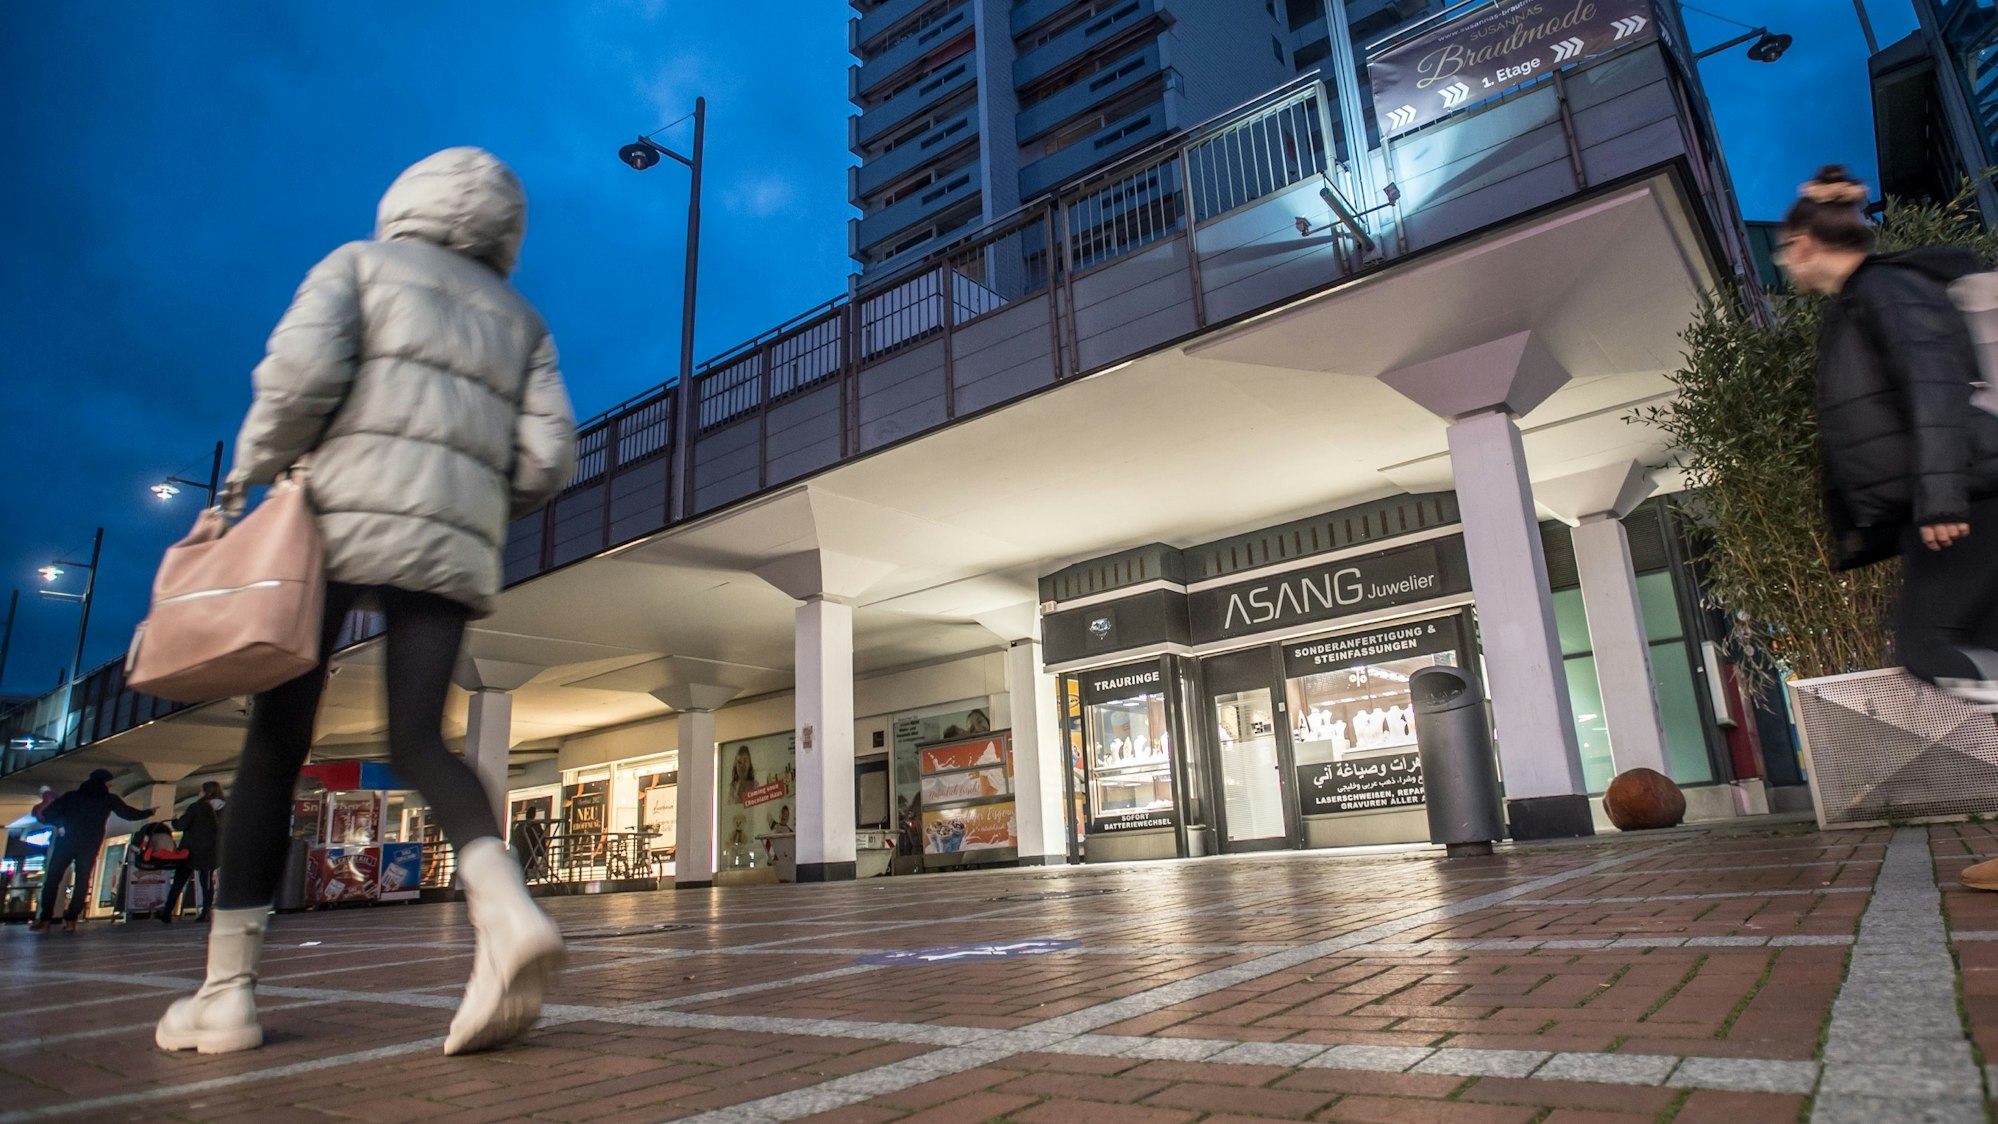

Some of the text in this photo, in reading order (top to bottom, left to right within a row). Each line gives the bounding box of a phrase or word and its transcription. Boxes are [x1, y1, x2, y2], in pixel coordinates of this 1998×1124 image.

[1437, 0, 1535, 42] www.susannas-brautm
[1470, 4, 1543, 41] SUSANNAS
[1416, 0, 1597, 89] Brautmode
[1482, 57, 1541, 89] 1. Etage
[1224, 567, 1435, 629] ASANG Juwelier
[1294, 624, 1436, 658] SONDERANFERTIGUNG &
[1314, 639, 1418, 665] STEINFASSUNGEN
[1094, 671, 1160, 692] TRAURINGE
[577, 806, 598, 821] NEU
[1121, 813, 1150, 822] SOFORT
[1341, 799, 1388, 810] GRAVUREN
[1390, 796, 1418, 805] ALLER
[1104, 818, 1172, 831] BATTERIEWECHSEL
